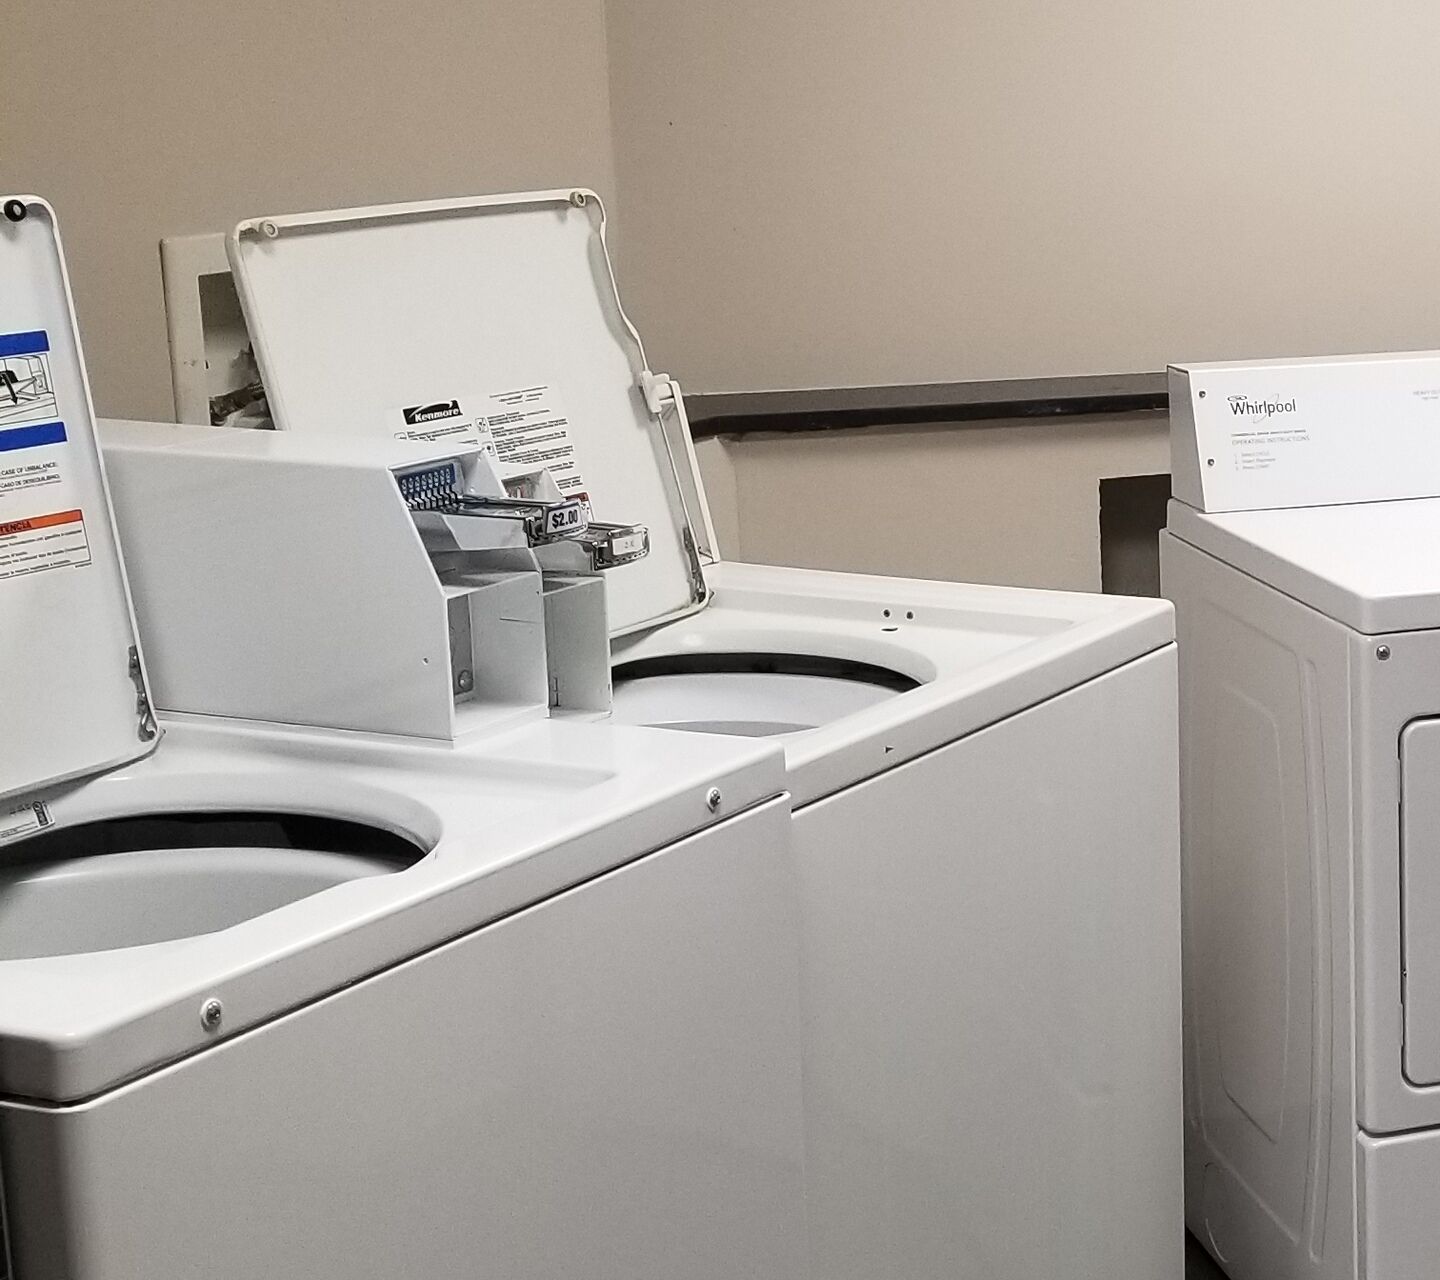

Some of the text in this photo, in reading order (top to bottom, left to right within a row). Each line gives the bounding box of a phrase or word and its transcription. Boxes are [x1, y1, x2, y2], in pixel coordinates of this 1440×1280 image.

[414, 408, 460, 423] Kenmore
[1230, 398, 1296, 418] Whirlpool
[552, 509, 579, 529] $2.00
